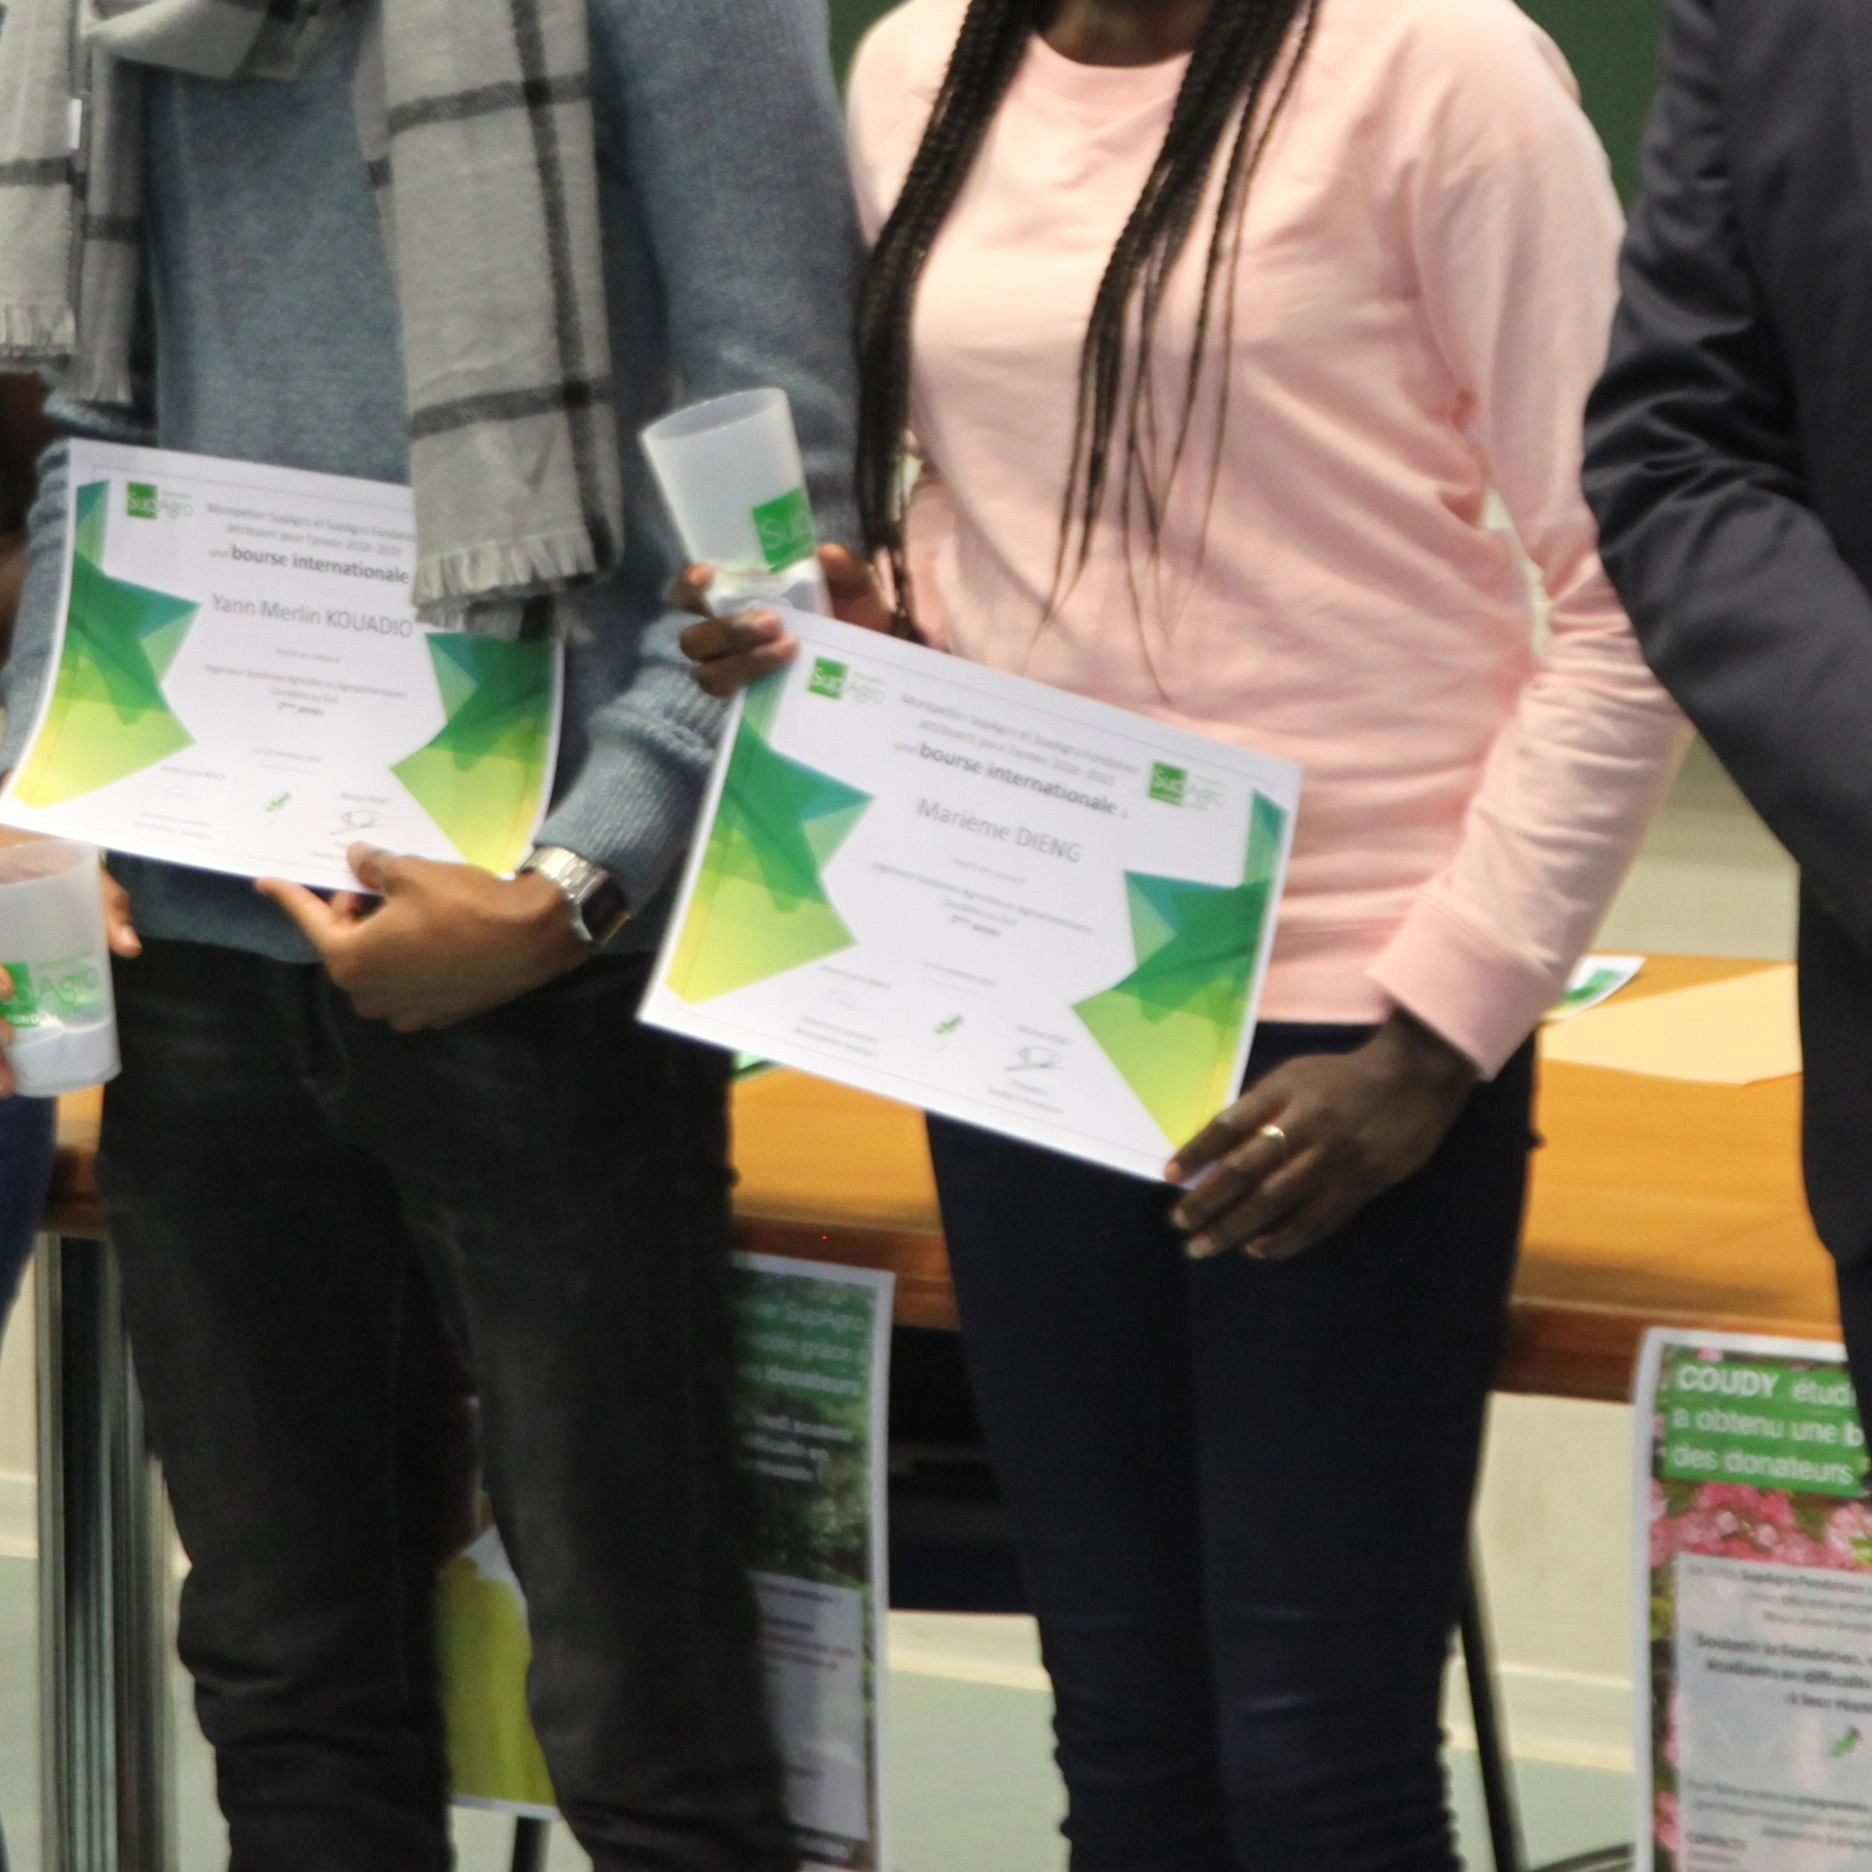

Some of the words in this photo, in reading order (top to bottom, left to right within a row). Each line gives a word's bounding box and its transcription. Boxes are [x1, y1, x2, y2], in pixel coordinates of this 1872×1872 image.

[231, 543, 288, 567] bourse
[292, 552, 410, 584] internationale
[211, 591, 255, 616] Yann
[260, 599, 321, 625] Merlin
[325, 608, 414, 638] KOUADIO
[917, 742, 983, 776] bourse
[987, 760, 1118, 816] internationale
[916, 797, 1010, 843] Marième
[1016, 824, 1084, 863] DIENG
[1677, 1364, 1781, 1398] COUDY
[1671, 1407, 1690, 1429] a
[1696, 1408, 1785, 1439] obtenu
[1791, 1420, 1839, 1445] une
[1671, 1443, 1720, 1471] des
[1724, 1448, 1855, 1486] donateurs
